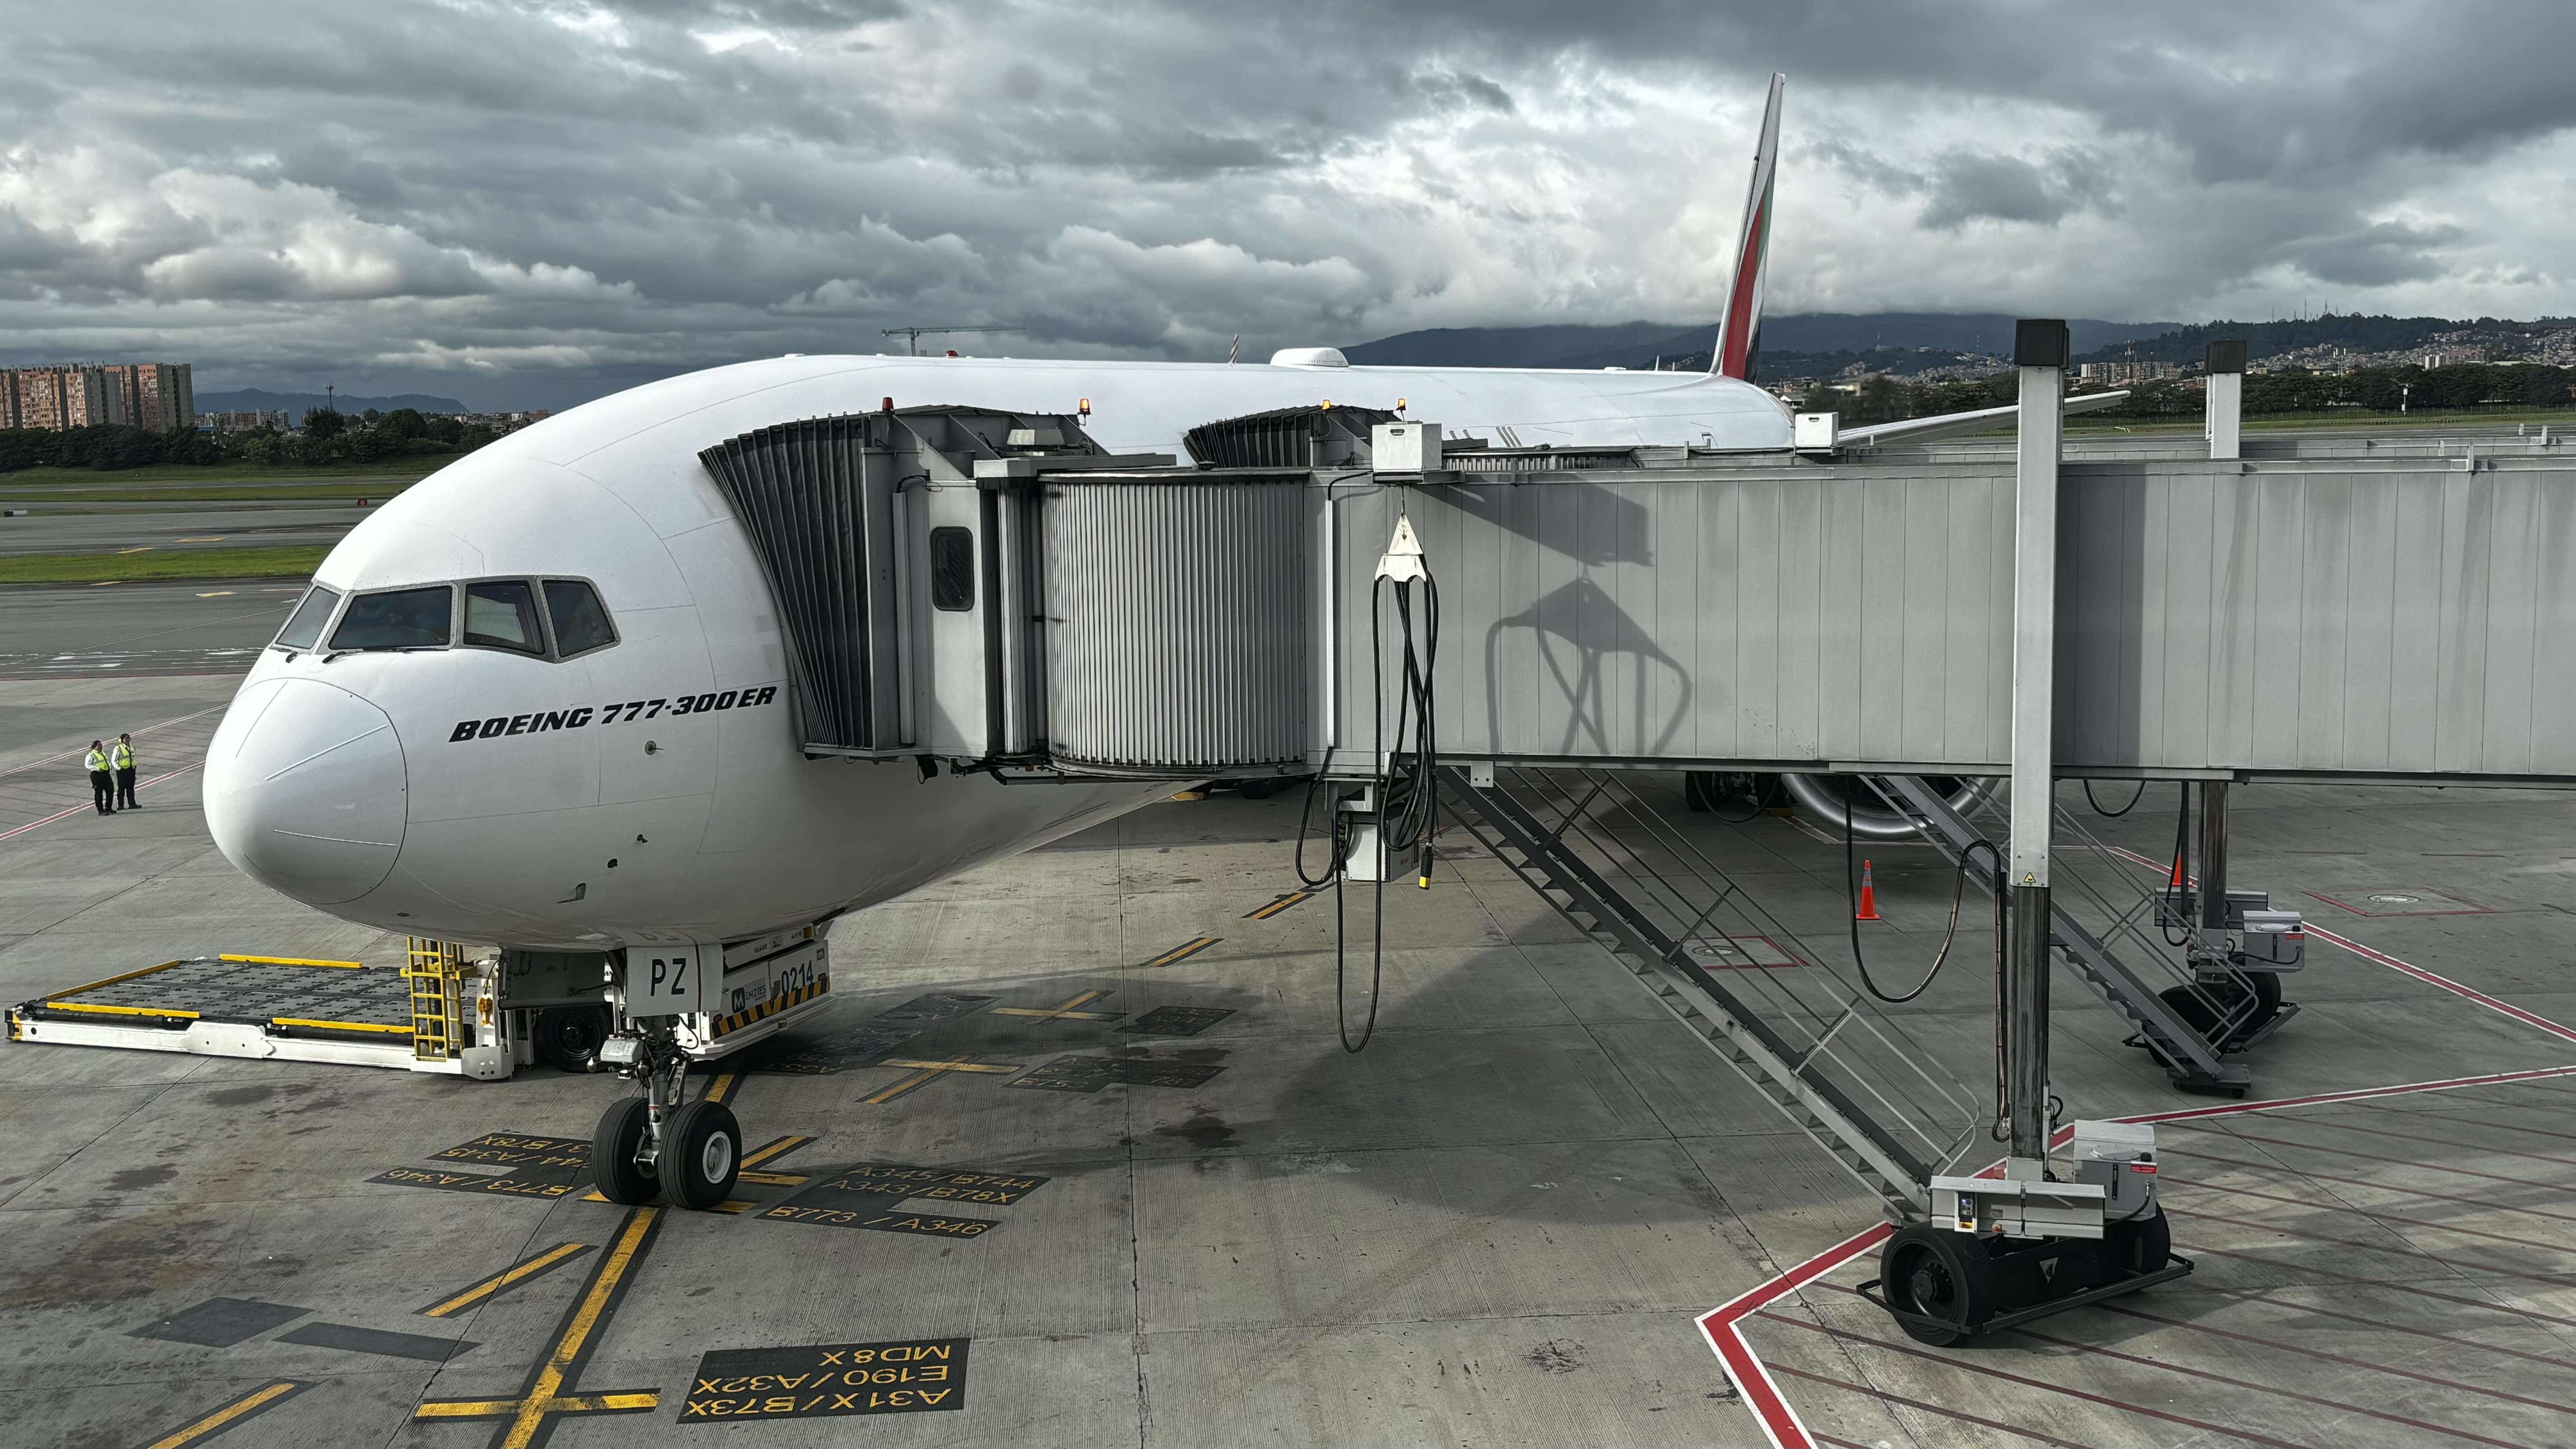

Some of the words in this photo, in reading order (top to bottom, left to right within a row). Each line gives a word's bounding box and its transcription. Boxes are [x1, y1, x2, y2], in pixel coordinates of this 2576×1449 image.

[449, 707, 593, 742] BOEING
[650, 958, 686, 996] PZ
[782, 960, 814, 994] 0214
